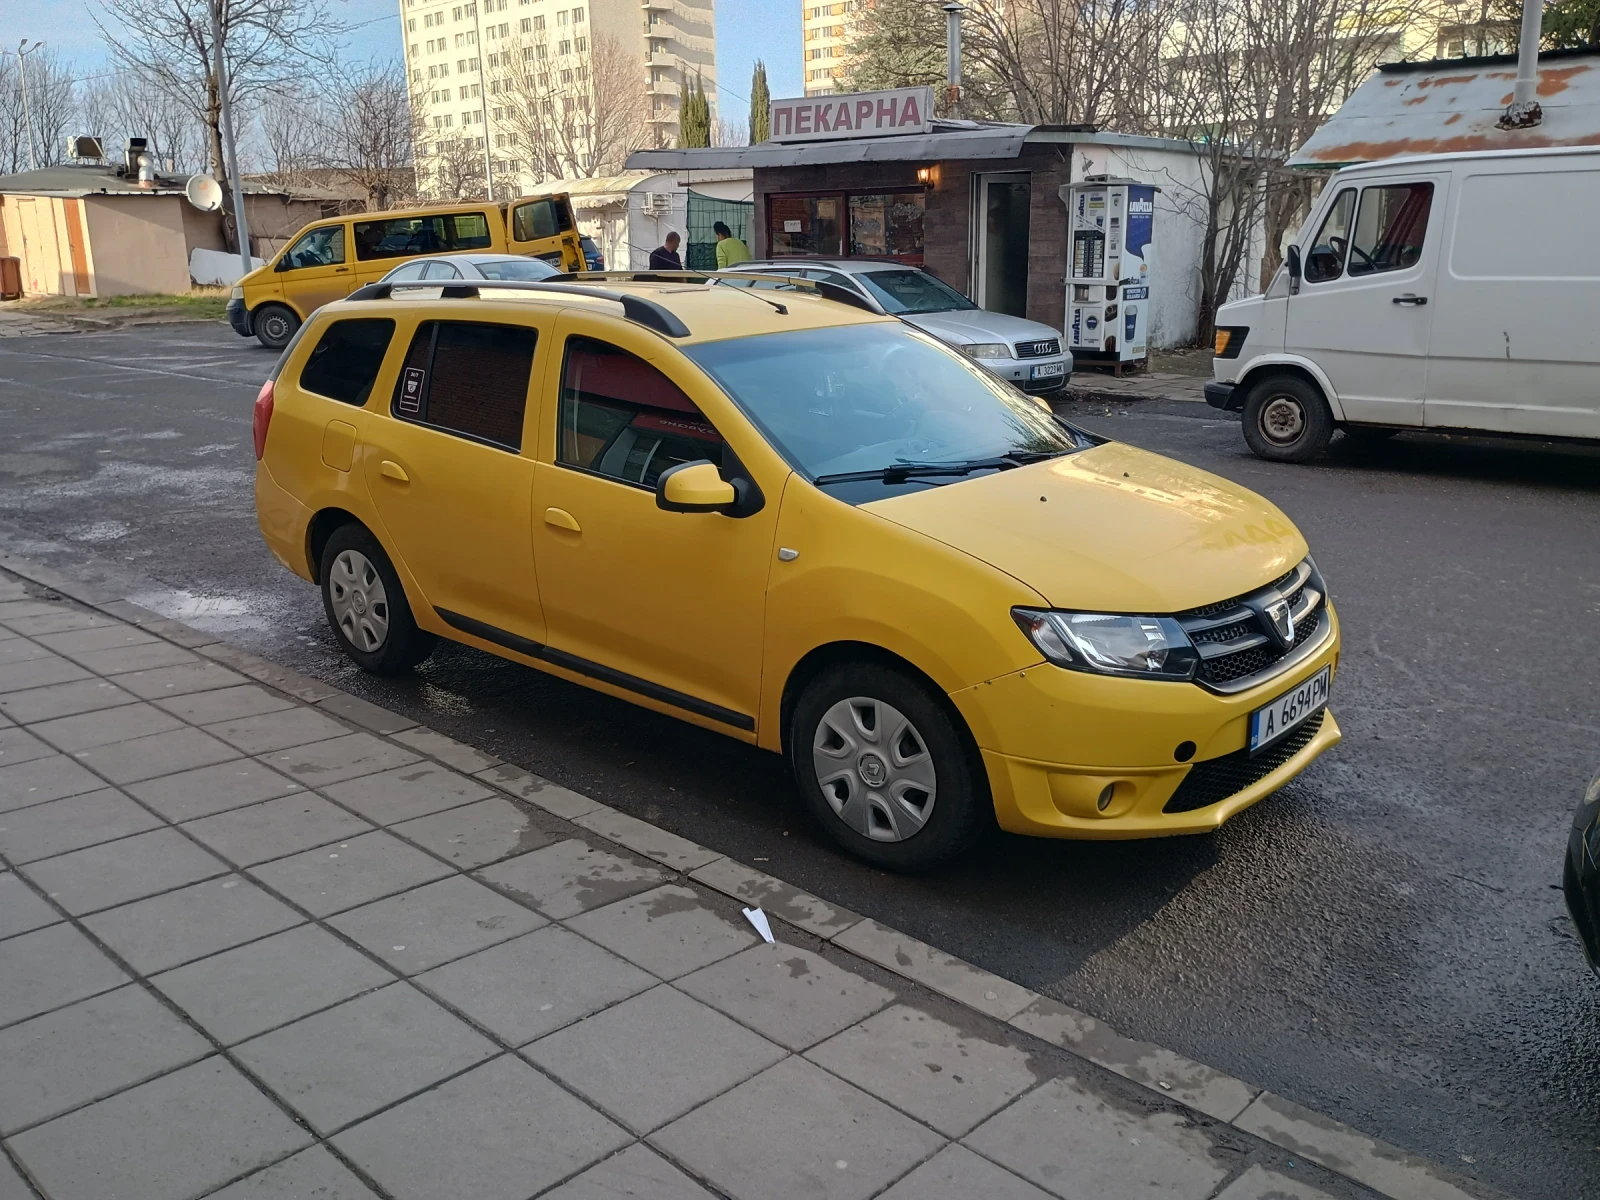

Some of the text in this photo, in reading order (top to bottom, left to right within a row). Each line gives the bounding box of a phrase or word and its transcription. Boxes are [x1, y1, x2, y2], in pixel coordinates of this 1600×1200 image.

[773, 96, 921, 136] ПЕКАРНА
[1128, 197, 1153, 213] LAVAZZA
[1072, 308, 1081, 345] LAVAZZA
[1265, 708, 1274, 738] A
